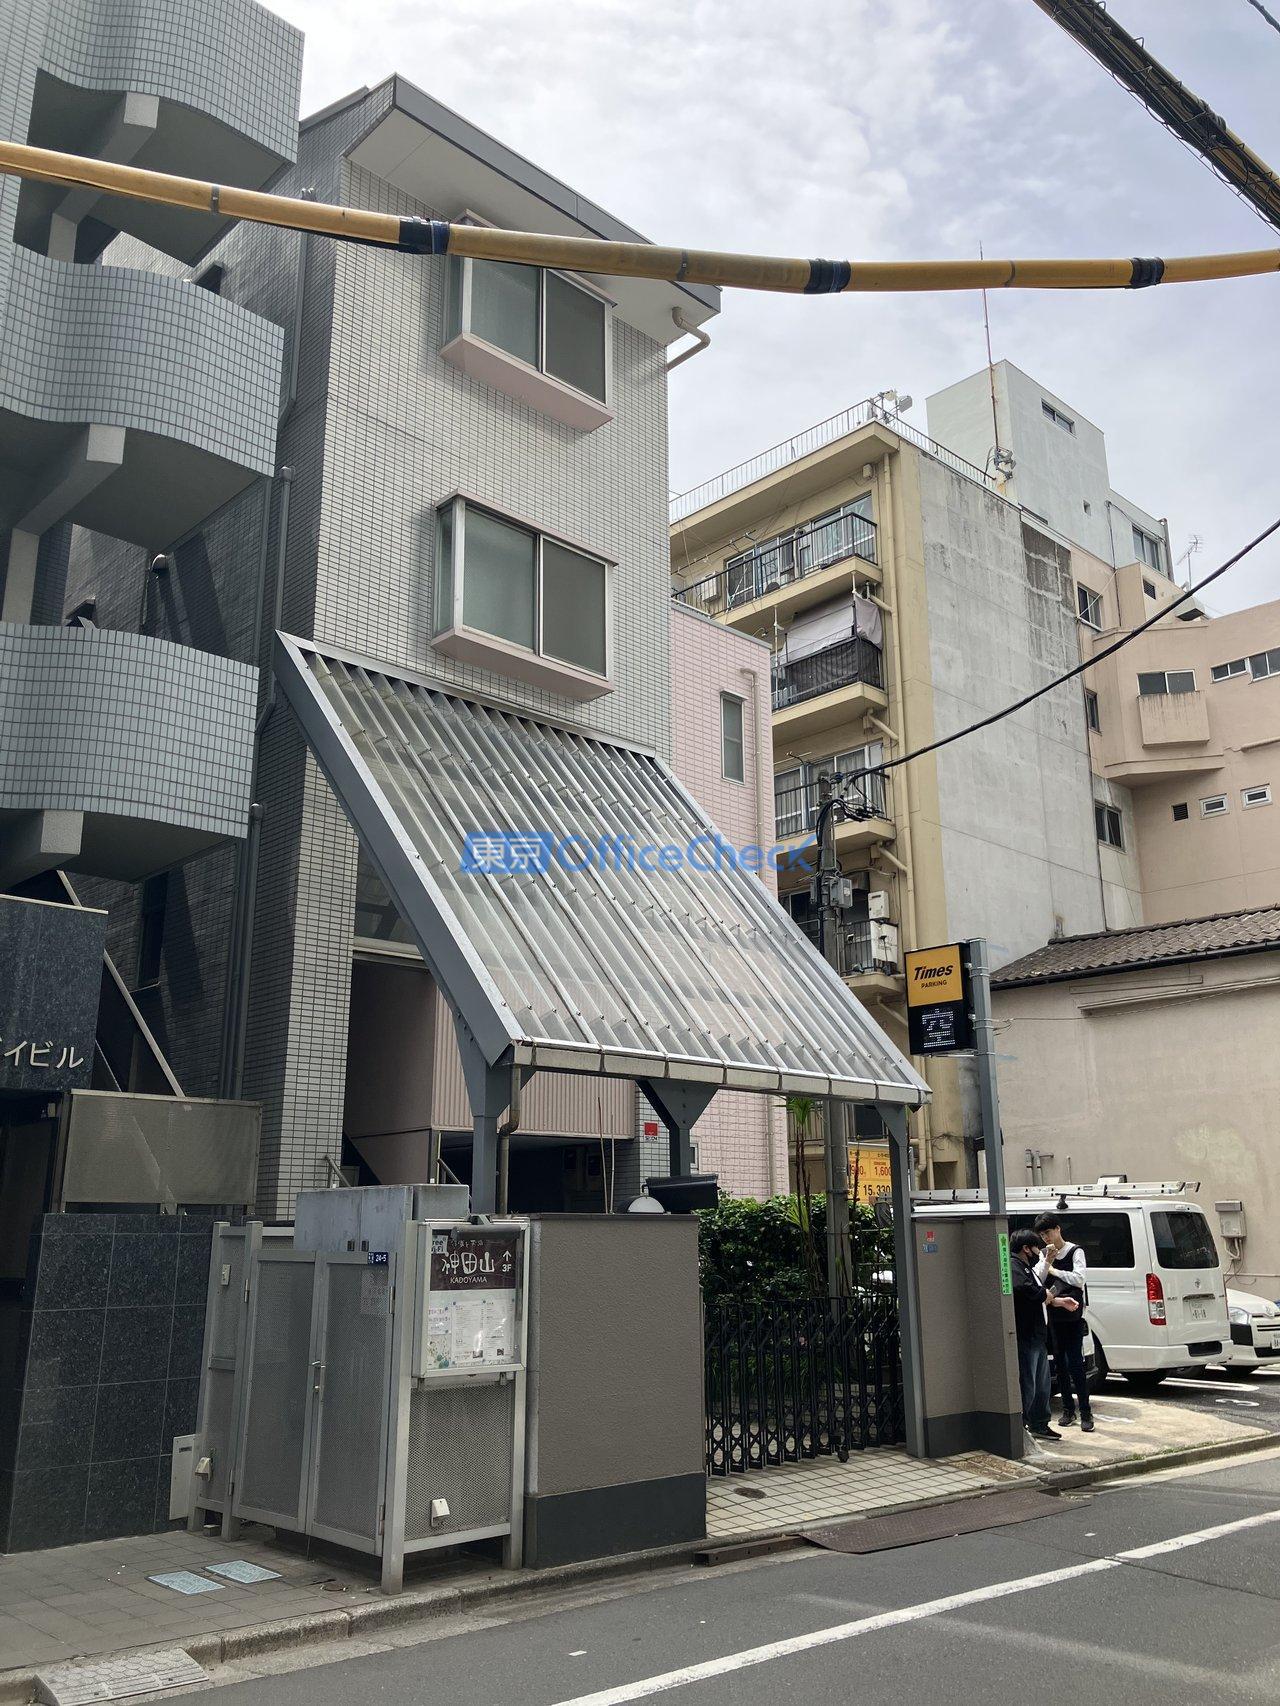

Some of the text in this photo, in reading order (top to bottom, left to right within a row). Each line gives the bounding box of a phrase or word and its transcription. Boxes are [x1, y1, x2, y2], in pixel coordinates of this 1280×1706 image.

[913, 964, 954, 981] Times
[921, 979, 948, 989] PARKING
[0, 1036, 84, 1069] イビル
[501, 1264, 512, 1272] 3F
[450, 1276, 487, 1284] KADOYAMA
